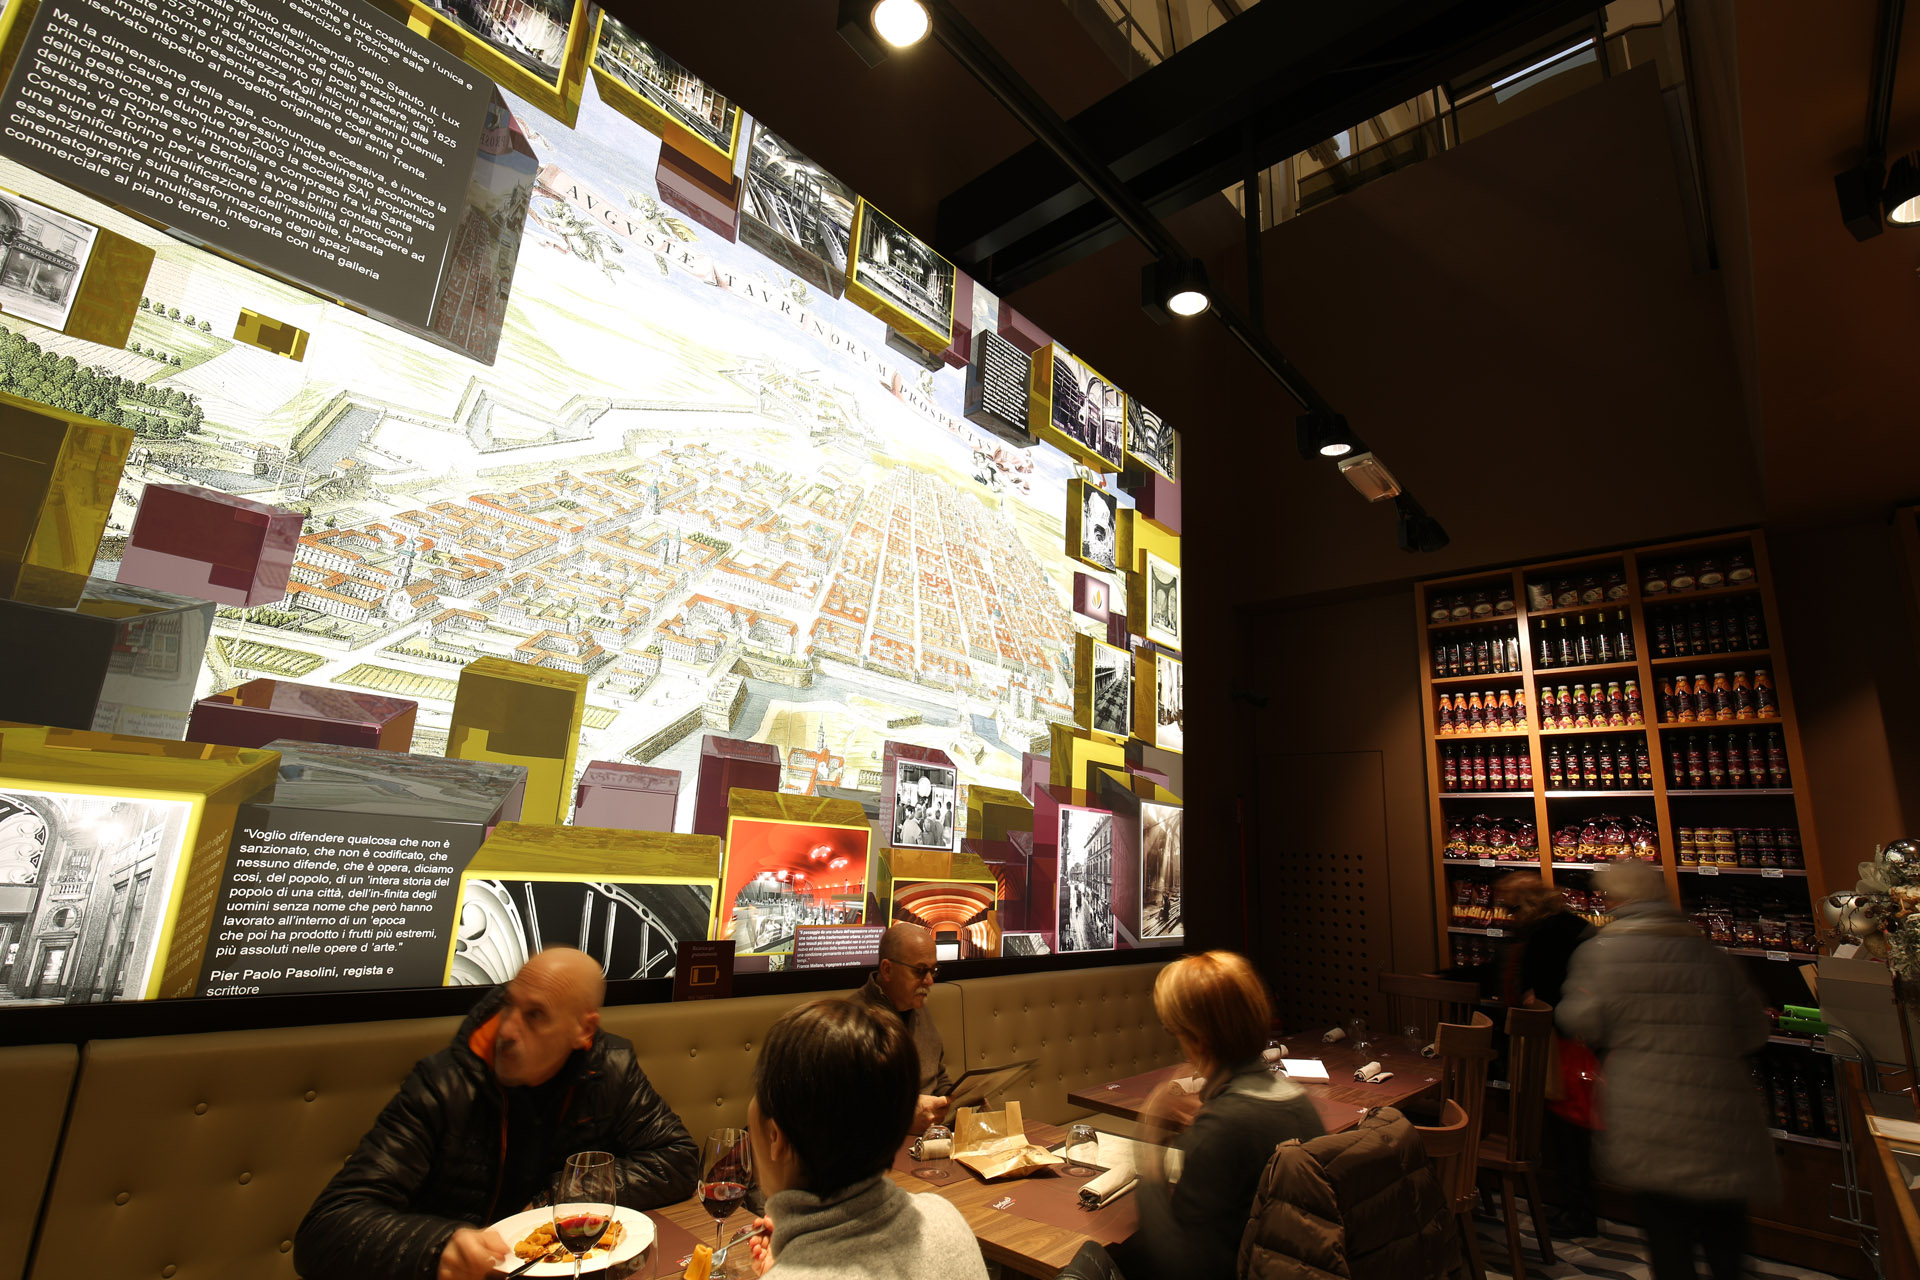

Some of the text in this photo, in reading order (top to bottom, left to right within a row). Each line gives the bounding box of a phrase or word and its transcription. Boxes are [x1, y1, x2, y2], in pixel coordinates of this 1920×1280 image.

[289, 2, 390, 66] esercizio a Torino.
[343, 22, 351, 30] e
[353, 28, 400, 59] preziose
[402, 57, 424, 73] sale
[352, 13, 373, 31] Lux
[375, 29, 430, 65] costituisce
[432, 61, 464, 85] l'unica
[234, 0, 279, 25] eguito
[282, 23, 355, 68] dell'incendio
[357, 66, 384, 85] dello
[386, 81, 426, 110] Statuto,
[430, 105, 439, 117] IL
[441, 112, 460, 128] Lux
[237, 10, 436, 127] rimodellazione dello spazio interno,
[47, 22, 435, 219] principale causa di un progressivo indebolimento economico
[152, 32, 204, 63] rispetto
[208, 62, 221, 72] al
[223, 70, 277, 101] progetto
[280, 100, 332, 130] originale
[334, 128, 363, 146] degli
[364, 143, 389, 160] anni
[392, 154, 427, 180] Trenta.
[181, 34, 194, 44] si
[196, 42, 255, 77] presenta
[257, 74, 342, 123] perfettamente
[345, 121, 394, 150] coerente
[396, 147, 404, 155] e
[37, 48, 412, 233] dell'intero complesso immobiliare compreso fra via Santa
[5, 127, 230, 230] commerciale al piano terreno.
[10, 114, 380, 280] cinematografici in multisala, integrata con una galleria
[16, 100, 350, 254] essenzialmente sulla trasformazione degli spazi
[21, 86, 384, 257] una significativa riqualificazione dell'immobile, basata
[236, 859, 454, 874] nessuno difende, che è opera, diciamo
[239, 844, 448, 862] sanzionato, che non è codificato, che
[289, 831, 345, 843] difendere
[347, 835, 397, 846] qualcosa
[399, 837, 419, 847] che
[421, 840, 441, 848] non
[443, 839, 450, 849] è
[226, 901, 433, 914] uomini senza nome che però hanno
[229, 886, 274, 899] popolo
[276, 887, 288, 897] di
[291, 889, 314, 897] una
[317, 887, 344, 899] città,
[412, 889, 437, 901] degli
[233, 872, 262, 884] cosi,
[266, 872, 286, 883] del
[288, 874, 332, 885] popolo,
[335, 874, 347, 884] di
[349, 876, 364, 884] un
[402, 876, 432, 886] storia
[434, 877, 450, 887] del
[219, 928, 437, 942] che poi ha prodotto i frutti più estremi,
[223, 915, 275, 926] lavorato
[339, 915, 350, 925] di
[352, 917, 367, 925] un
[210, 965, 394, 981] Pier Paolo Pasolini, regista e
[215, 945, 237, 958] più
[240, 944, 289, 955] assoluti
[292, 943, 321, 954] nelle
[324, 945, 358, 955] opere
[360, 942, 369, 952] d
[206, 985, 260, 997] scrittore
